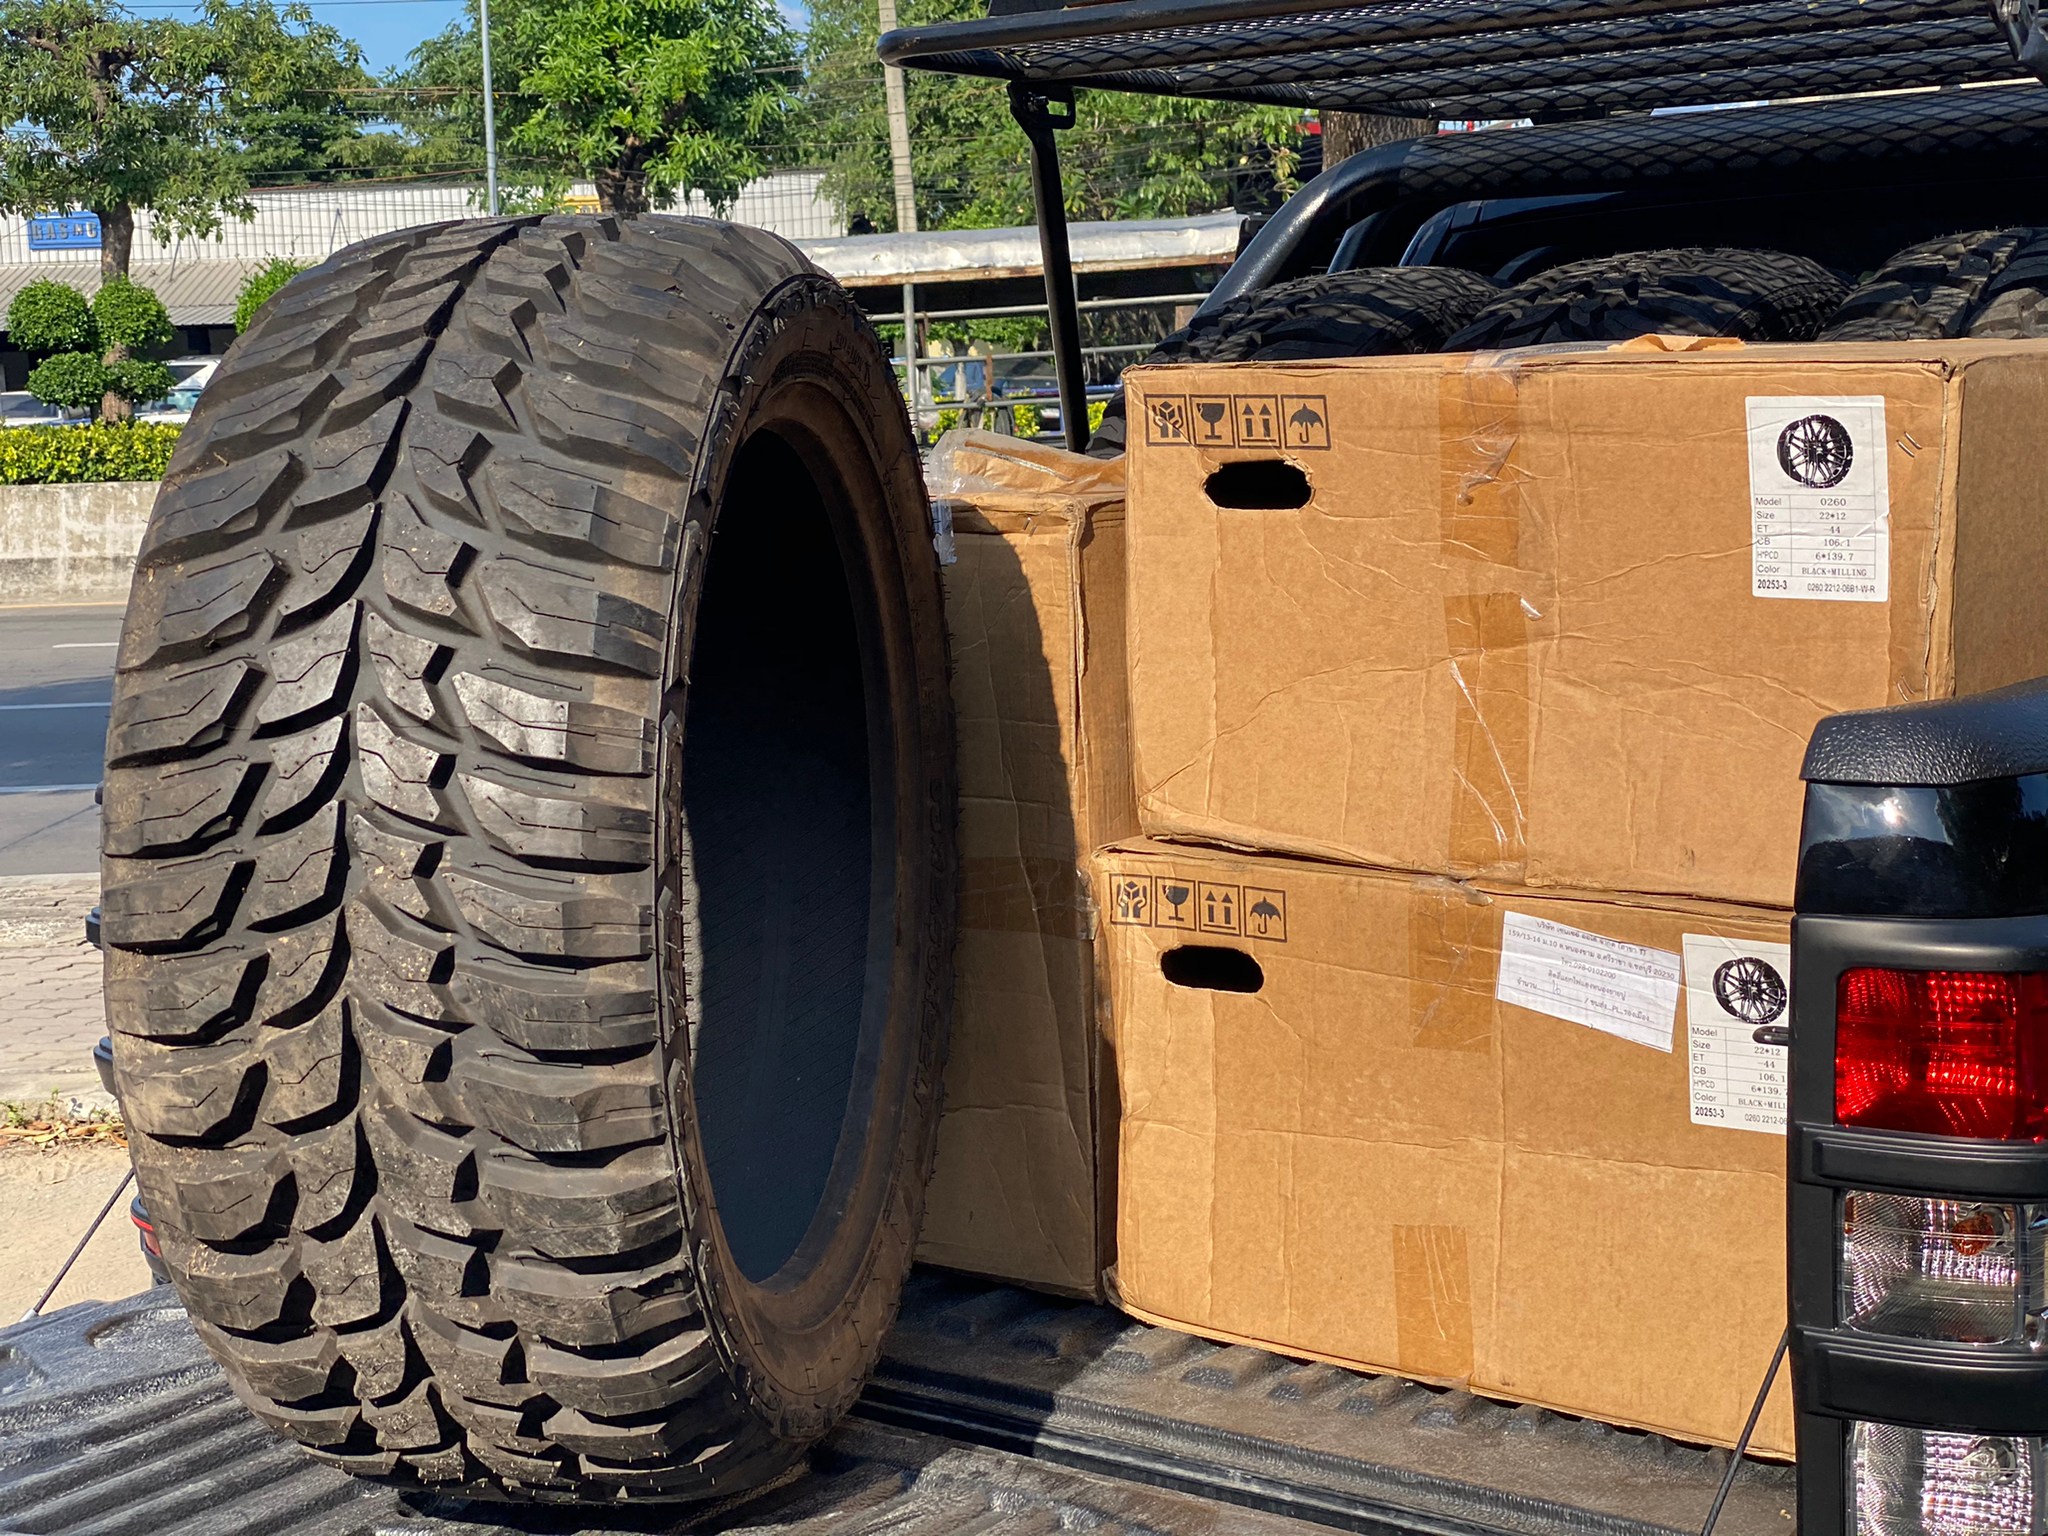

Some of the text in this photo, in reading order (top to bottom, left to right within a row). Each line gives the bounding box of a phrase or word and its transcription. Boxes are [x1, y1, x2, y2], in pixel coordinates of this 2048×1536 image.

[1756, 497, 1846, 506] Model 0260
[1756, 511, 1775, 519] Size
[1757, 525, 1768, 533] ET
[1758, 537, 1851, 547] CB 106.1
[1757, 565, 1867, 577] Color BLACK+MILLING
[1757, 579, 1787, 590] 20253-3
[1692, 1027, 1717, 1037] Model
[1693, 1040, 1711, 1050] Size
[1693, 1053, 1705, 1062] ET
[1694, 1067, 1785, 1082] CB 106.1
[1694, 1092, 1716, 1102] Color
[1695, 1107, 1725, 1118] 20253-3
